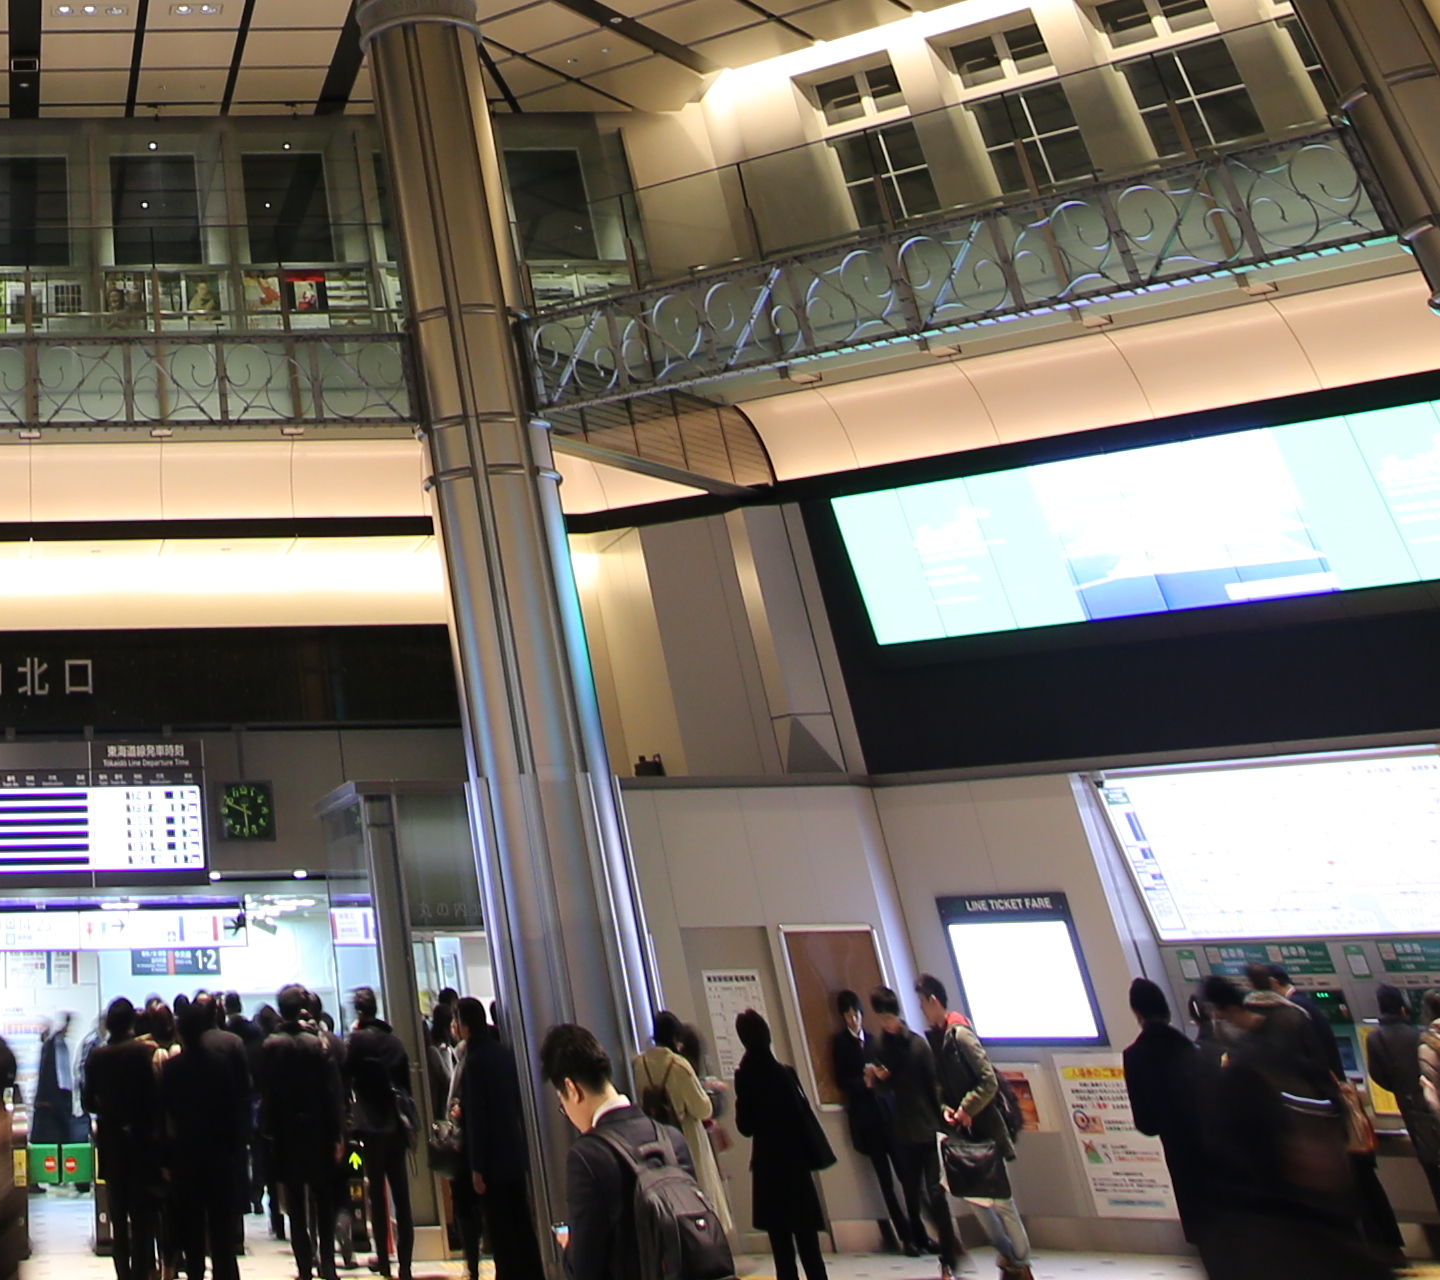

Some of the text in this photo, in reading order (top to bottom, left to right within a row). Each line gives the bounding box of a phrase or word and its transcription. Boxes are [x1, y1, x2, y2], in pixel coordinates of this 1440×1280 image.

[965, 897, 1053, 912] LINE TICKET FARE
